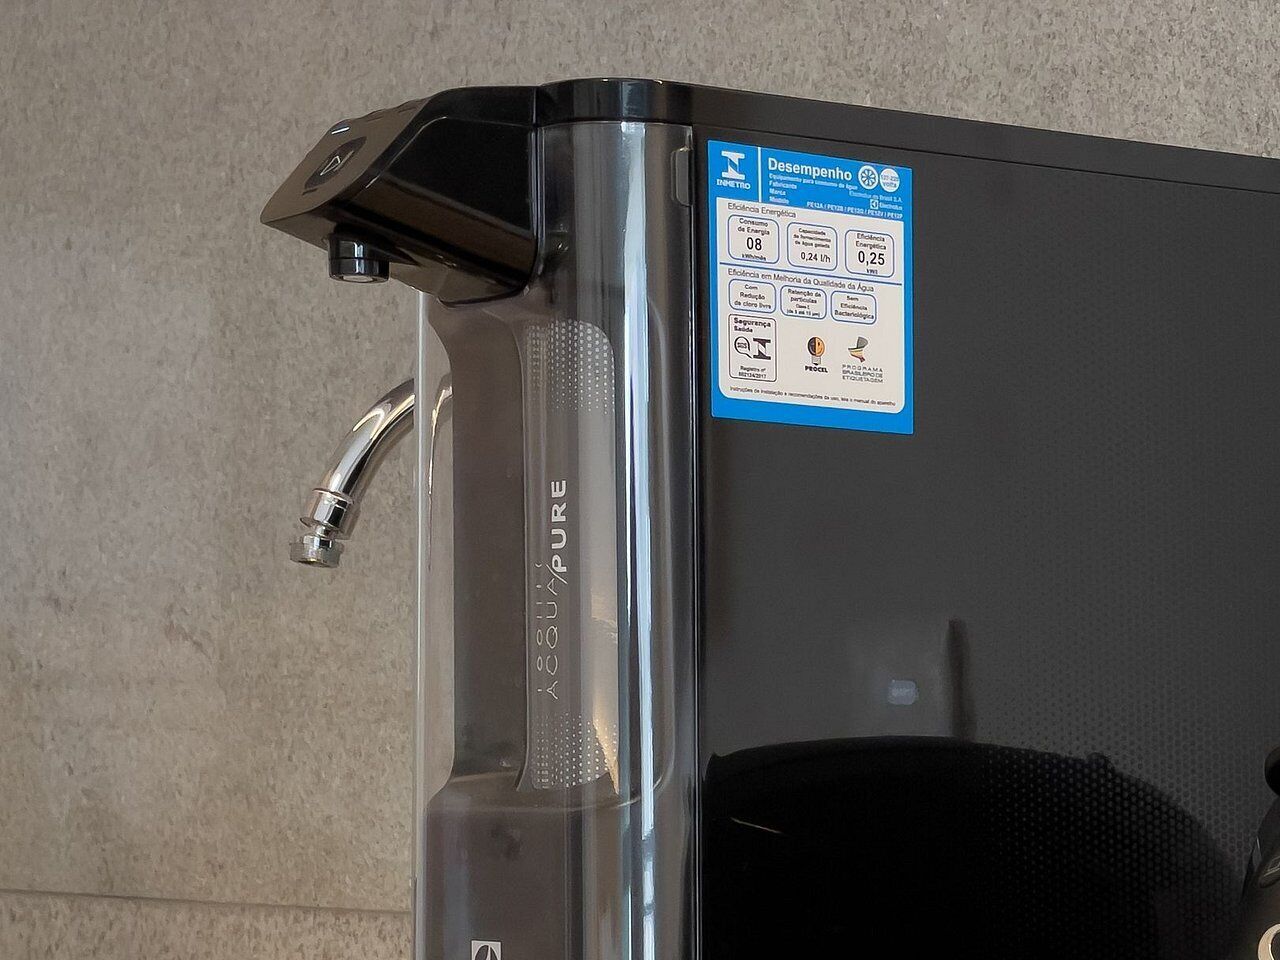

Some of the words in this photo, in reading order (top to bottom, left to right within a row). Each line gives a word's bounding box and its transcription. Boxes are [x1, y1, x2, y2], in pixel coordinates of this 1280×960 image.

[768, 157, 852, 181] Desempenho
[716, 179, 751, 190] INMETRO
[769, 188, 786, 196] Marca
[727, 202, 759, 214] Eficiência
[761, 206, 797, 218] Energética
[739, 218, 768, 227] Consumo
[747, 228, 770, 236] Energia
[857, 233, 885, 242] Eficiência
[746, 237, 762, 251] 08
[856, 240, 886, 250] Energética
[800, 251, 818, 262] 0,24
[858, 250, 885, 266] 0,25
[727, 268, 759, 279] Eficiência
[773, 274, 801, 284] Melhoria
[803, 277, 812, 285] da
[813, 279, 846, 290] Qualidade
[847, 282, 856, 290] da
[857, 282, 874, 293] Água
[740, 292, 765, 300] Redução
[787, 289, 813, 298] Retenção
[834, 310, 874, 320] Bacteriológica
[734, 317, 771, 328] Segurança
[734, 325, 753, 333] Saúde
[805, 365, 828, 374] PROCEL
[842, 364, 883, 372] PROGRAMA
[842, 375, 883, 383] ETIQUETAGEM
[551, 479, 567, 573] PURE
[546, 573, 559, 700] ACQUA
